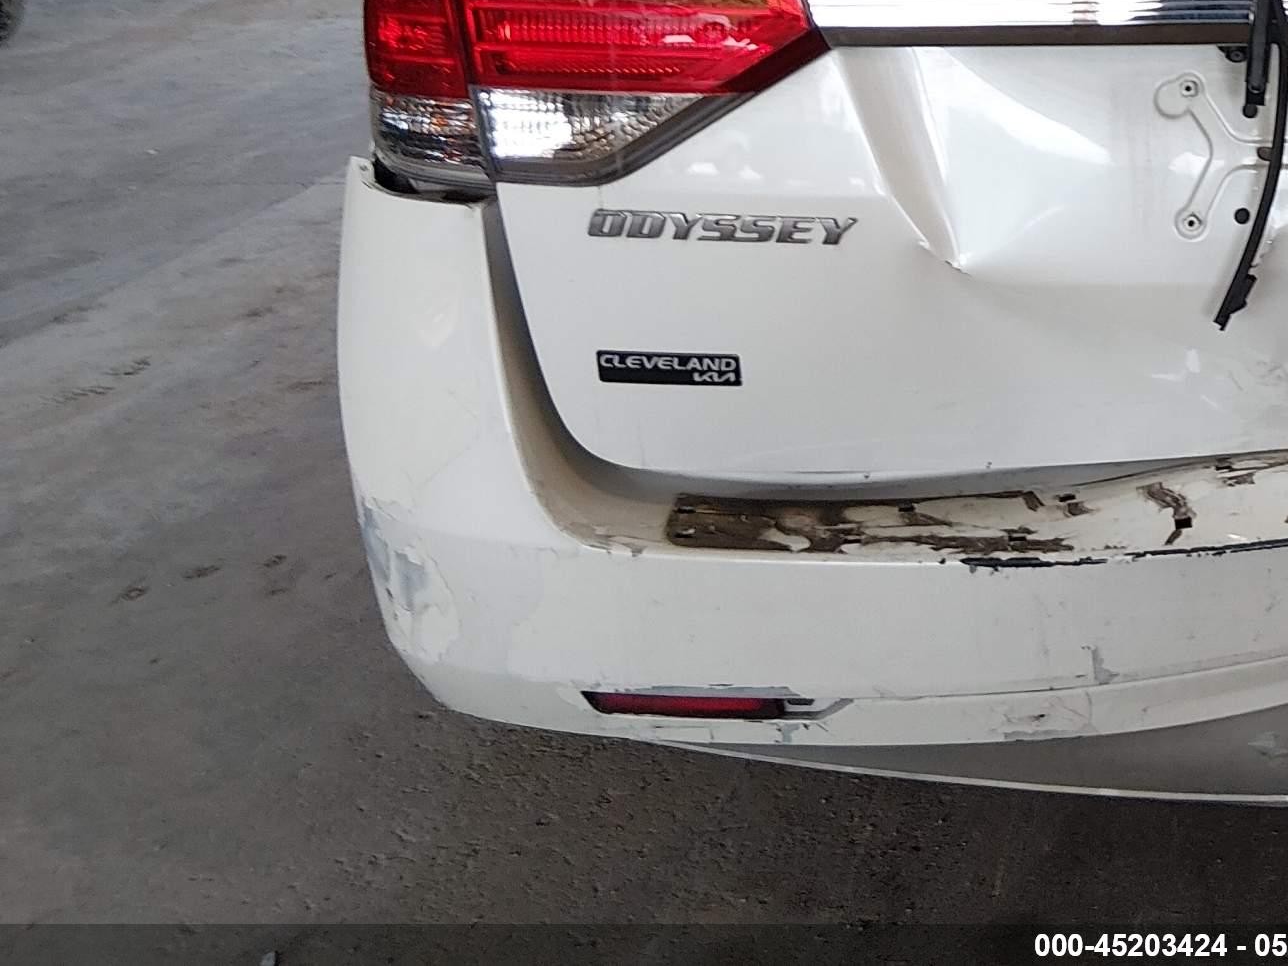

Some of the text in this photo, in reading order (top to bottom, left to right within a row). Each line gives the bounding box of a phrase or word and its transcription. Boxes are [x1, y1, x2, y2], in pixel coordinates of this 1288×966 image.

[588, 209, 857, 244] ODYSSEY
[600, 354, 737, 371] CLEVELAND
[692, 371, 736, 383] KIA
